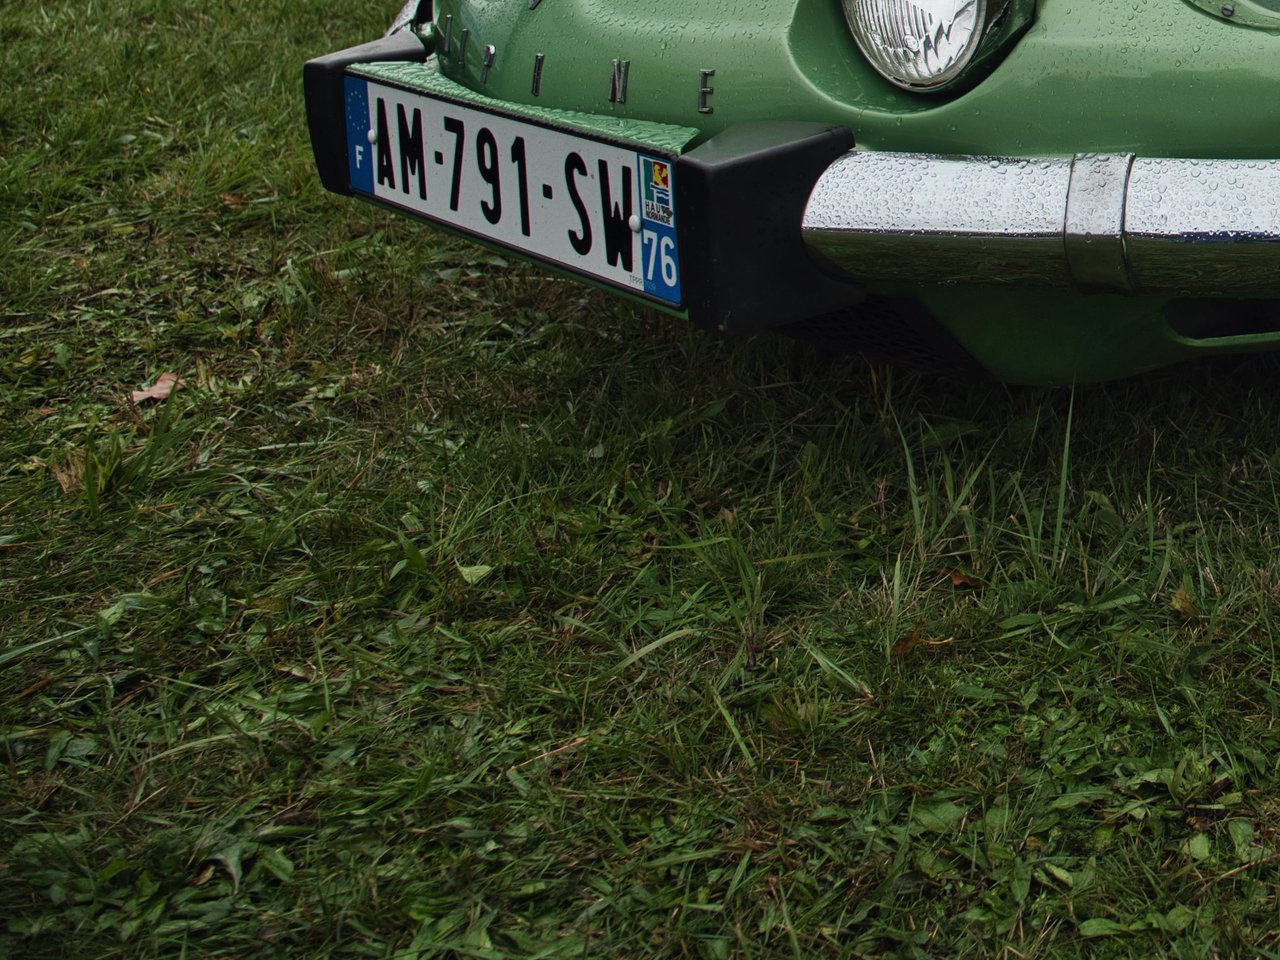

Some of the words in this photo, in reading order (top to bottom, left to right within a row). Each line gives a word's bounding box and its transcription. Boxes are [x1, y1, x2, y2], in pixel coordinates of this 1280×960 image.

[354, 144, 366, 170] F
[645, 200, 673, 217] HAU
[643, 228, 678, 288] 76
